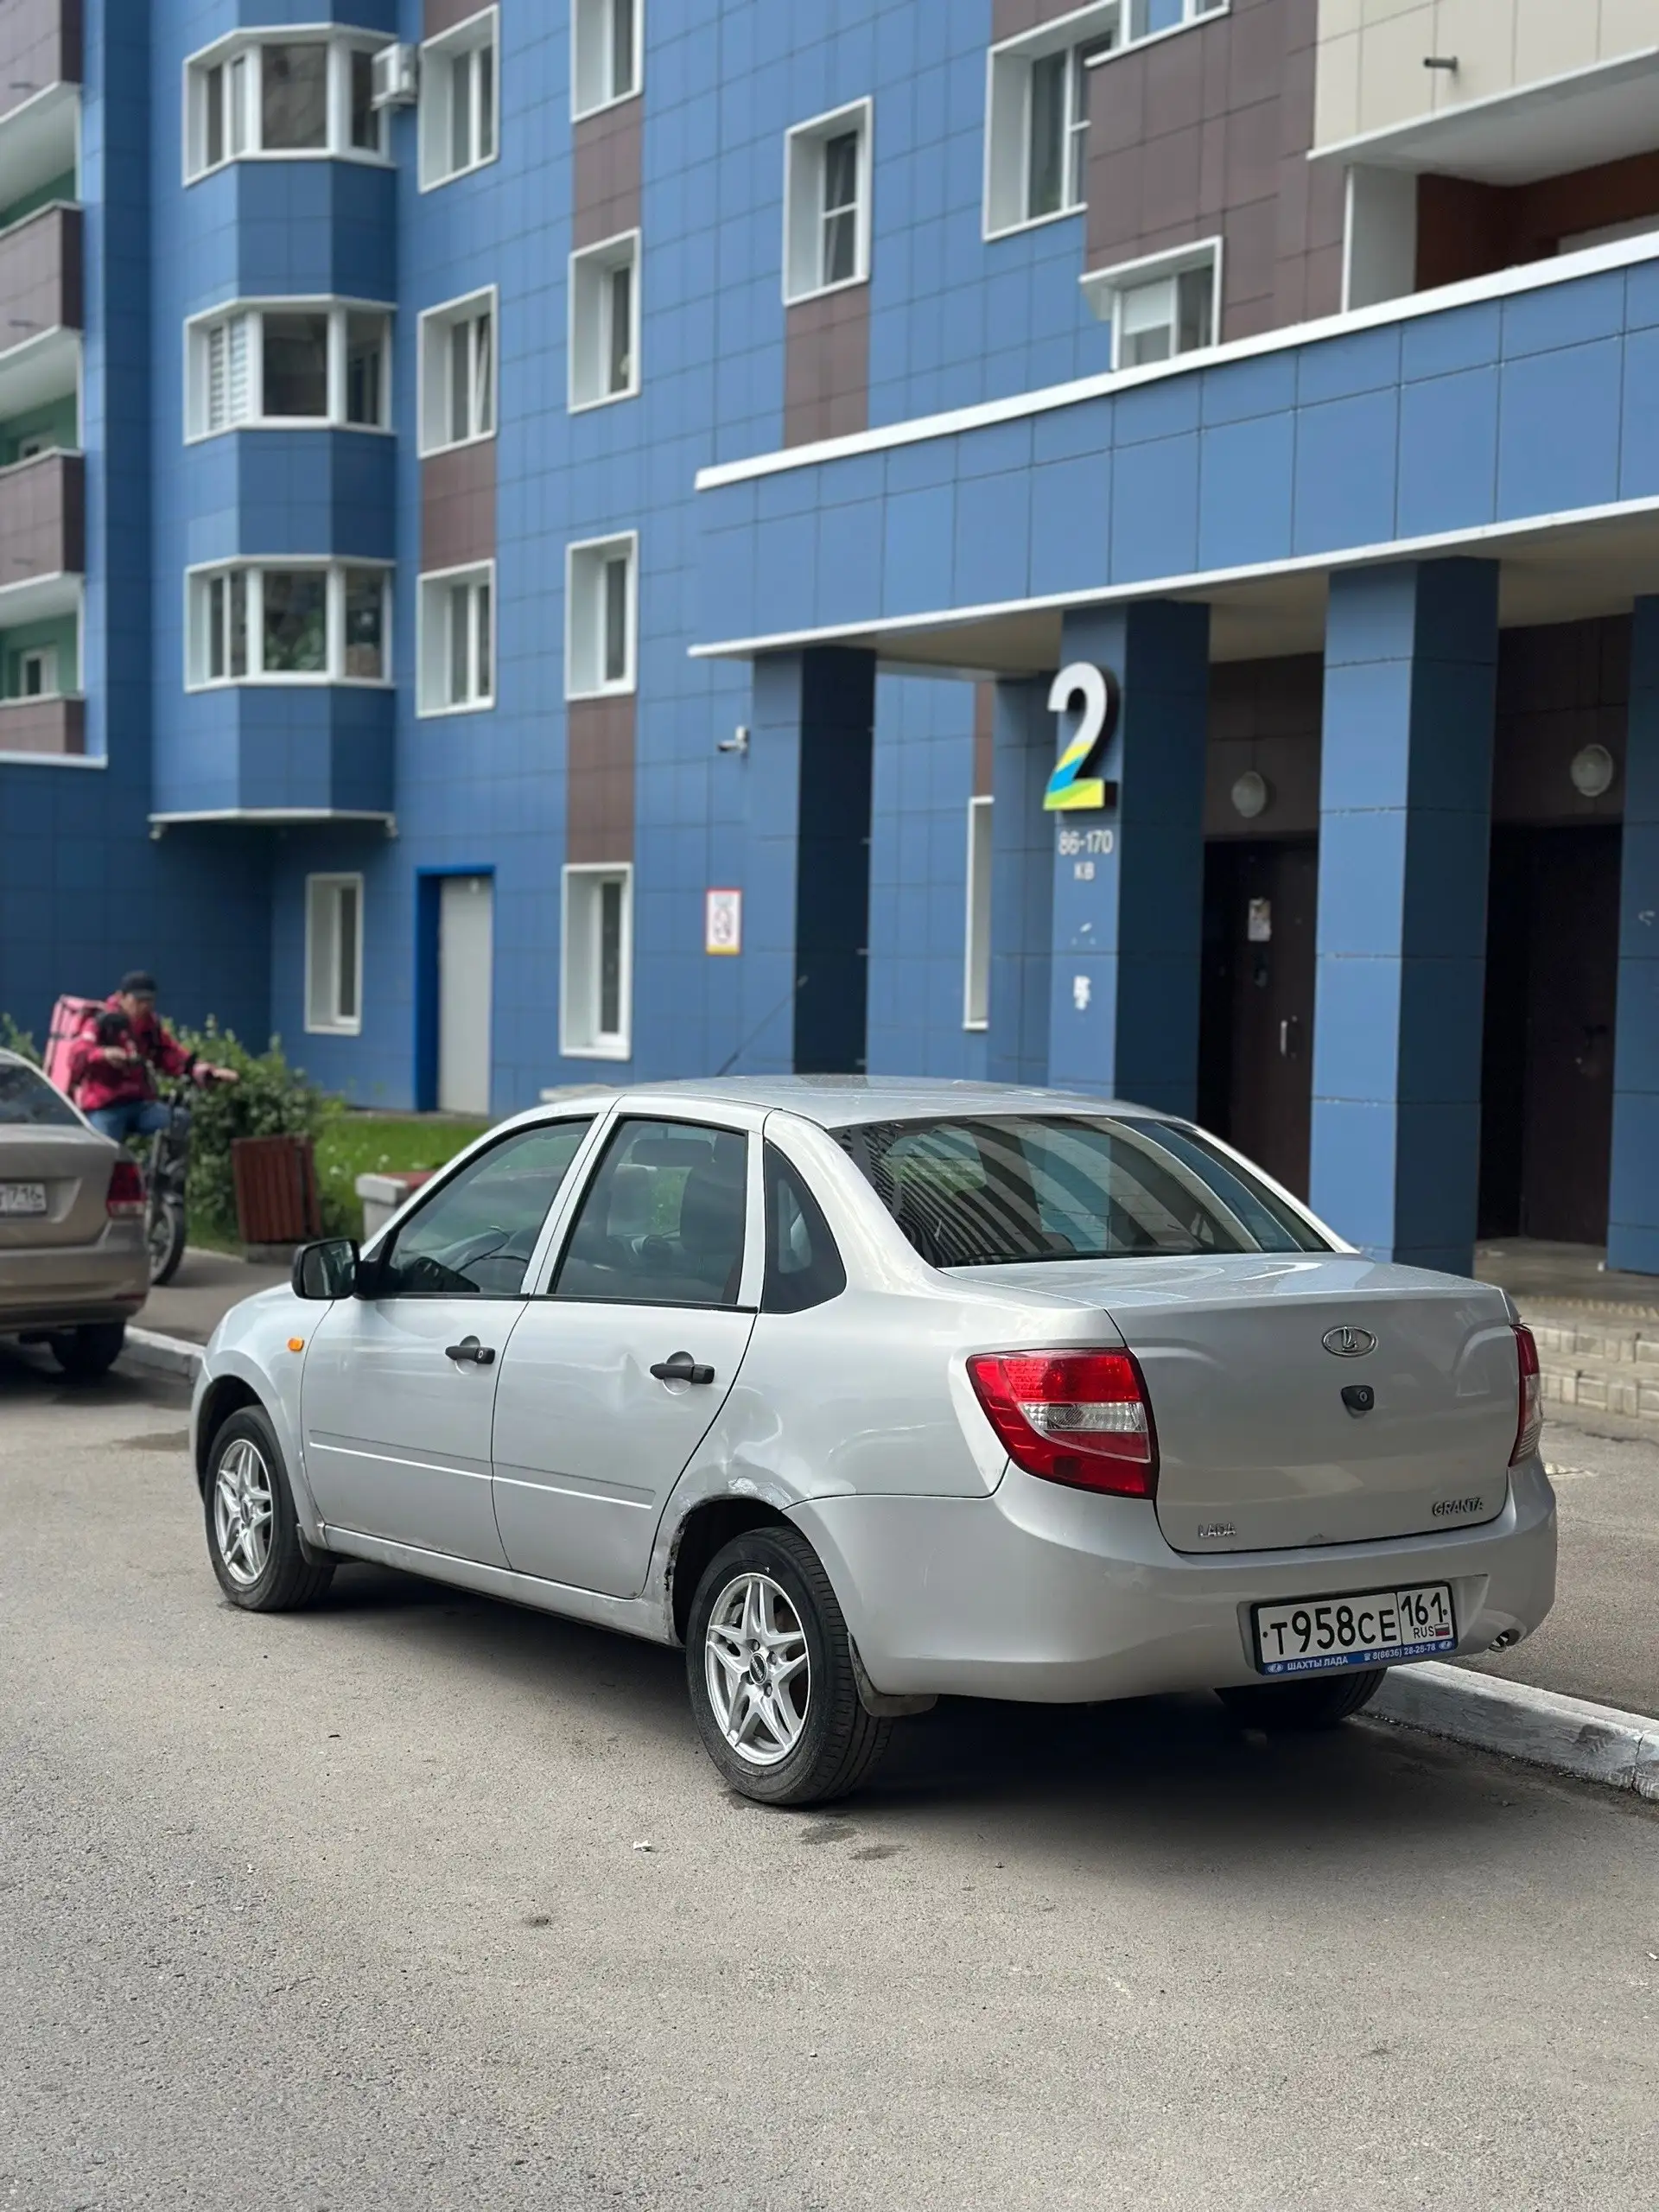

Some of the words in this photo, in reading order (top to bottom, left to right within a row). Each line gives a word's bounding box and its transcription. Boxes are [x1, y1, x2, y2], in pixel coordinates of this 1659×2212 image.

[1043, 662, 1108, 810] 2
[1058, 830, 1114, 855] 86-170
[1432, 1497, 1484, 1516] GRANTA
[1198, 1522, 1236, 1538] LADA
[1401, 1592, 1444, 1627] 161
[1413, 1625, 1435, 1639] RUS
[1287, 1657, 1322, 1671] ШАХТЫ
[1324, 1656, 1349, 1668] ЛАДА
